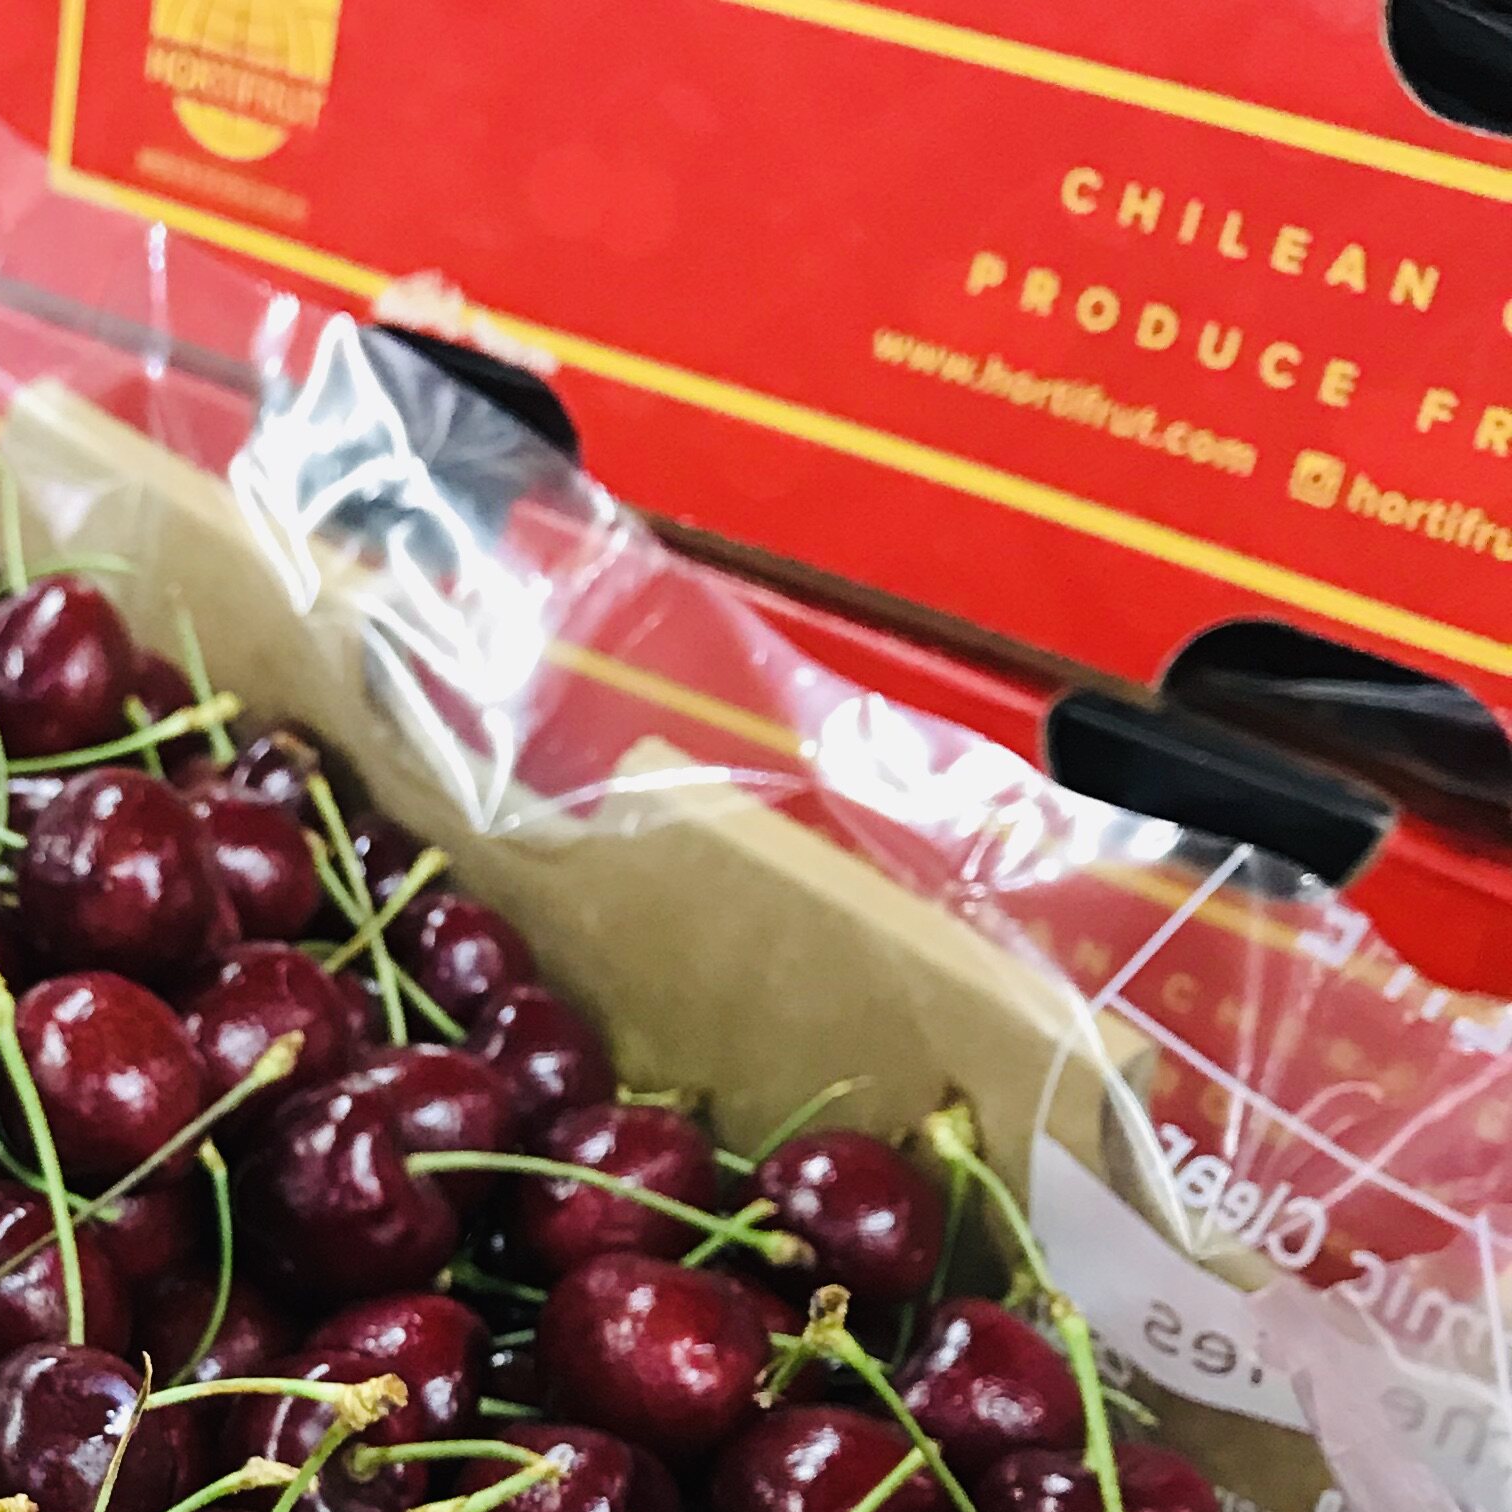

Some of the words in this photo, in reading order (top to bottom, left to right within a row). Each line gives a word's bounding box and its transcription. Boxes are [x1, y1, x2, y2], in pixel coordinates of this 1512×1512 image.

[1060, 166, 1440, 312] CHILEAN
[872, 326, 1258, 478] www.hortifrut.com
[964, 250, 1361, 408] PRODUCE
